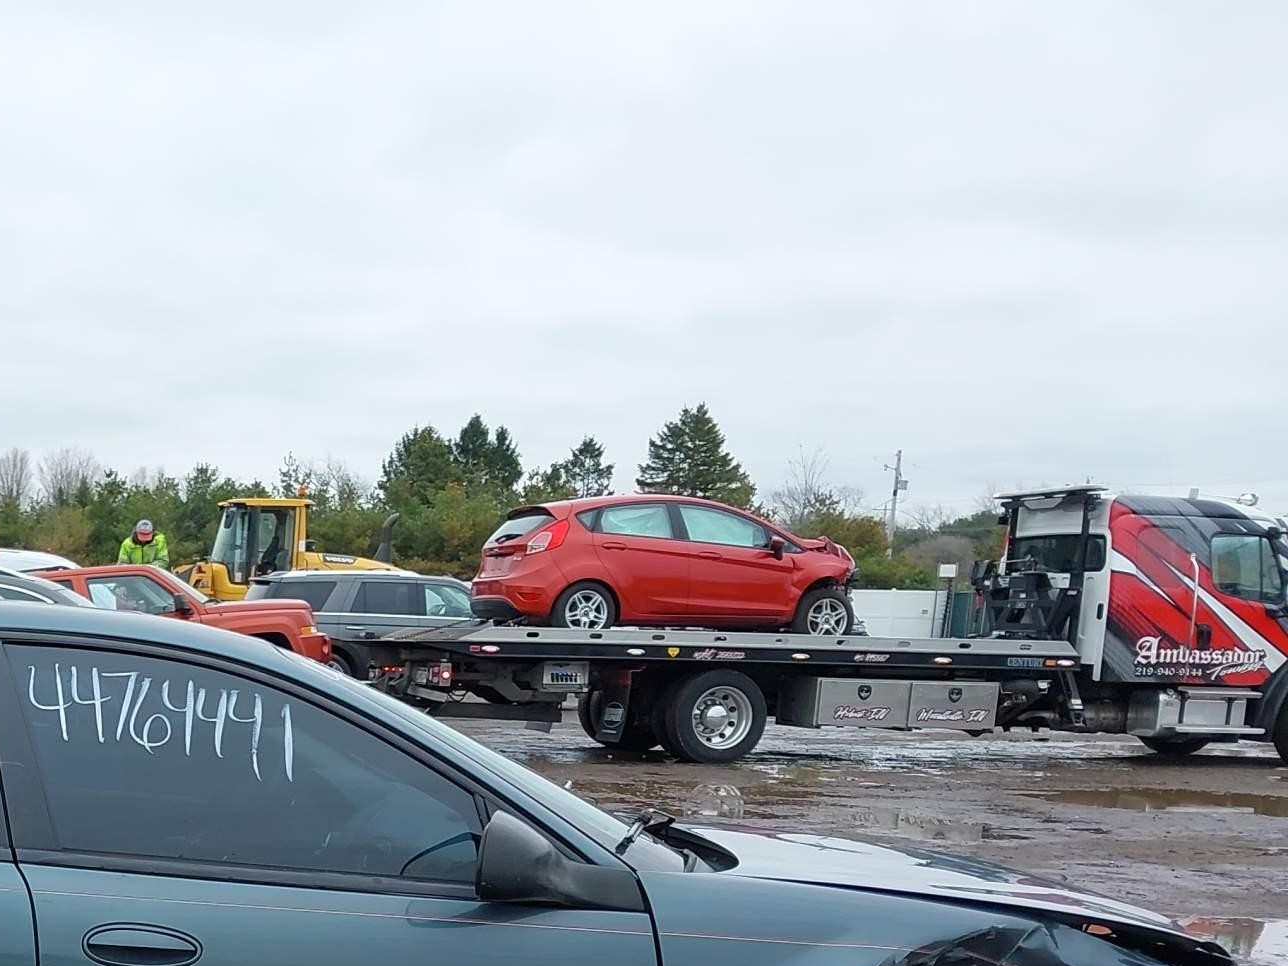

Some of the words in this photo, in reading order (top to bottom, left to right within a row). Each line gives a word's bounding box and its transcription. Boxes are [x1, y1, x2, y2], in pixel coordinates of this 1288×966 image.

[1134, 636, 1265, 665] Ambassador
[1135, 666, 1202, 677] 219-940-9144
[27, 663, 294, 783] 44764441
